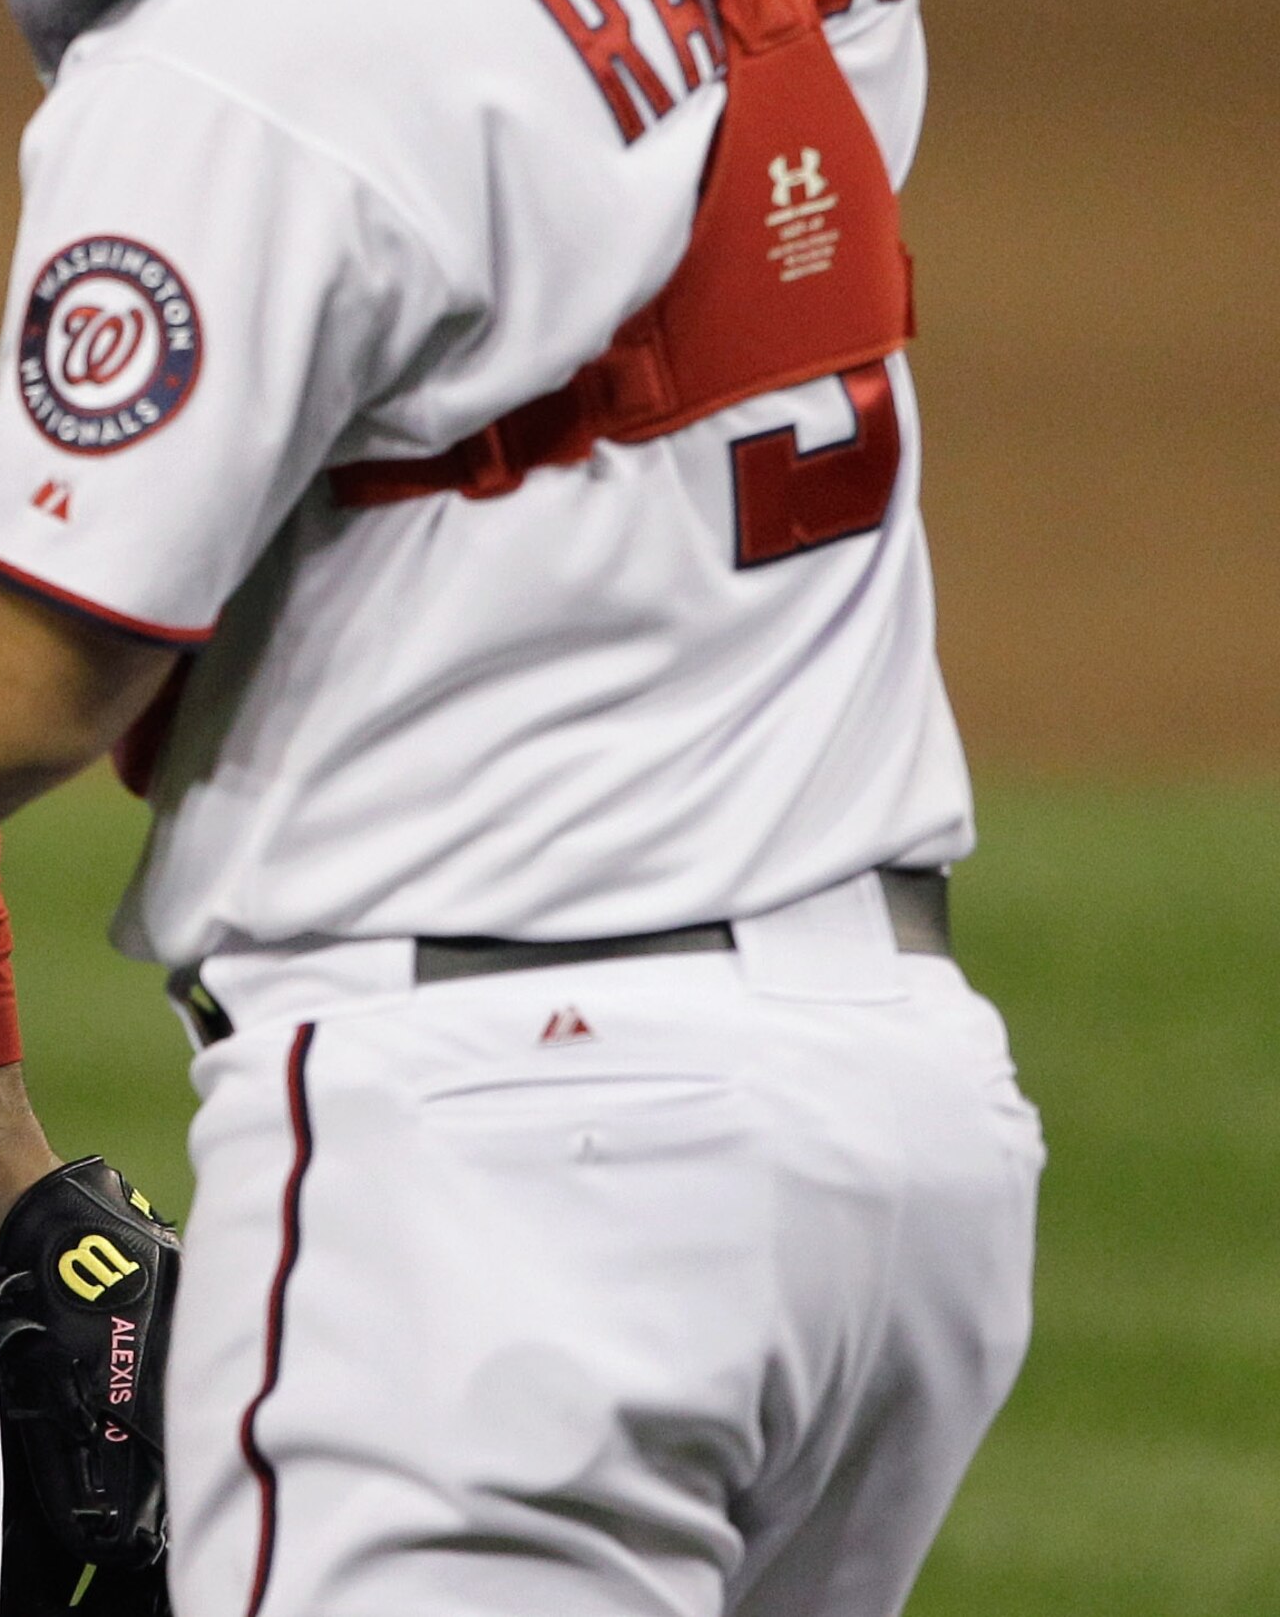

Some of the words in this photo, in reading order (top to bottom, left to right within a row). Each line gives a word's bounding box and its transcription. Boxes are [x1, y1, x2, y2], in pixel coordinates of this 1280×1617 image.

[35, 241, 195, 351] WASHINGTON
[61, 305, 145, 387] W
[20, 356, 161, 447] NATIONALS
[108, 1314, 136, 1405] ALEXIS
